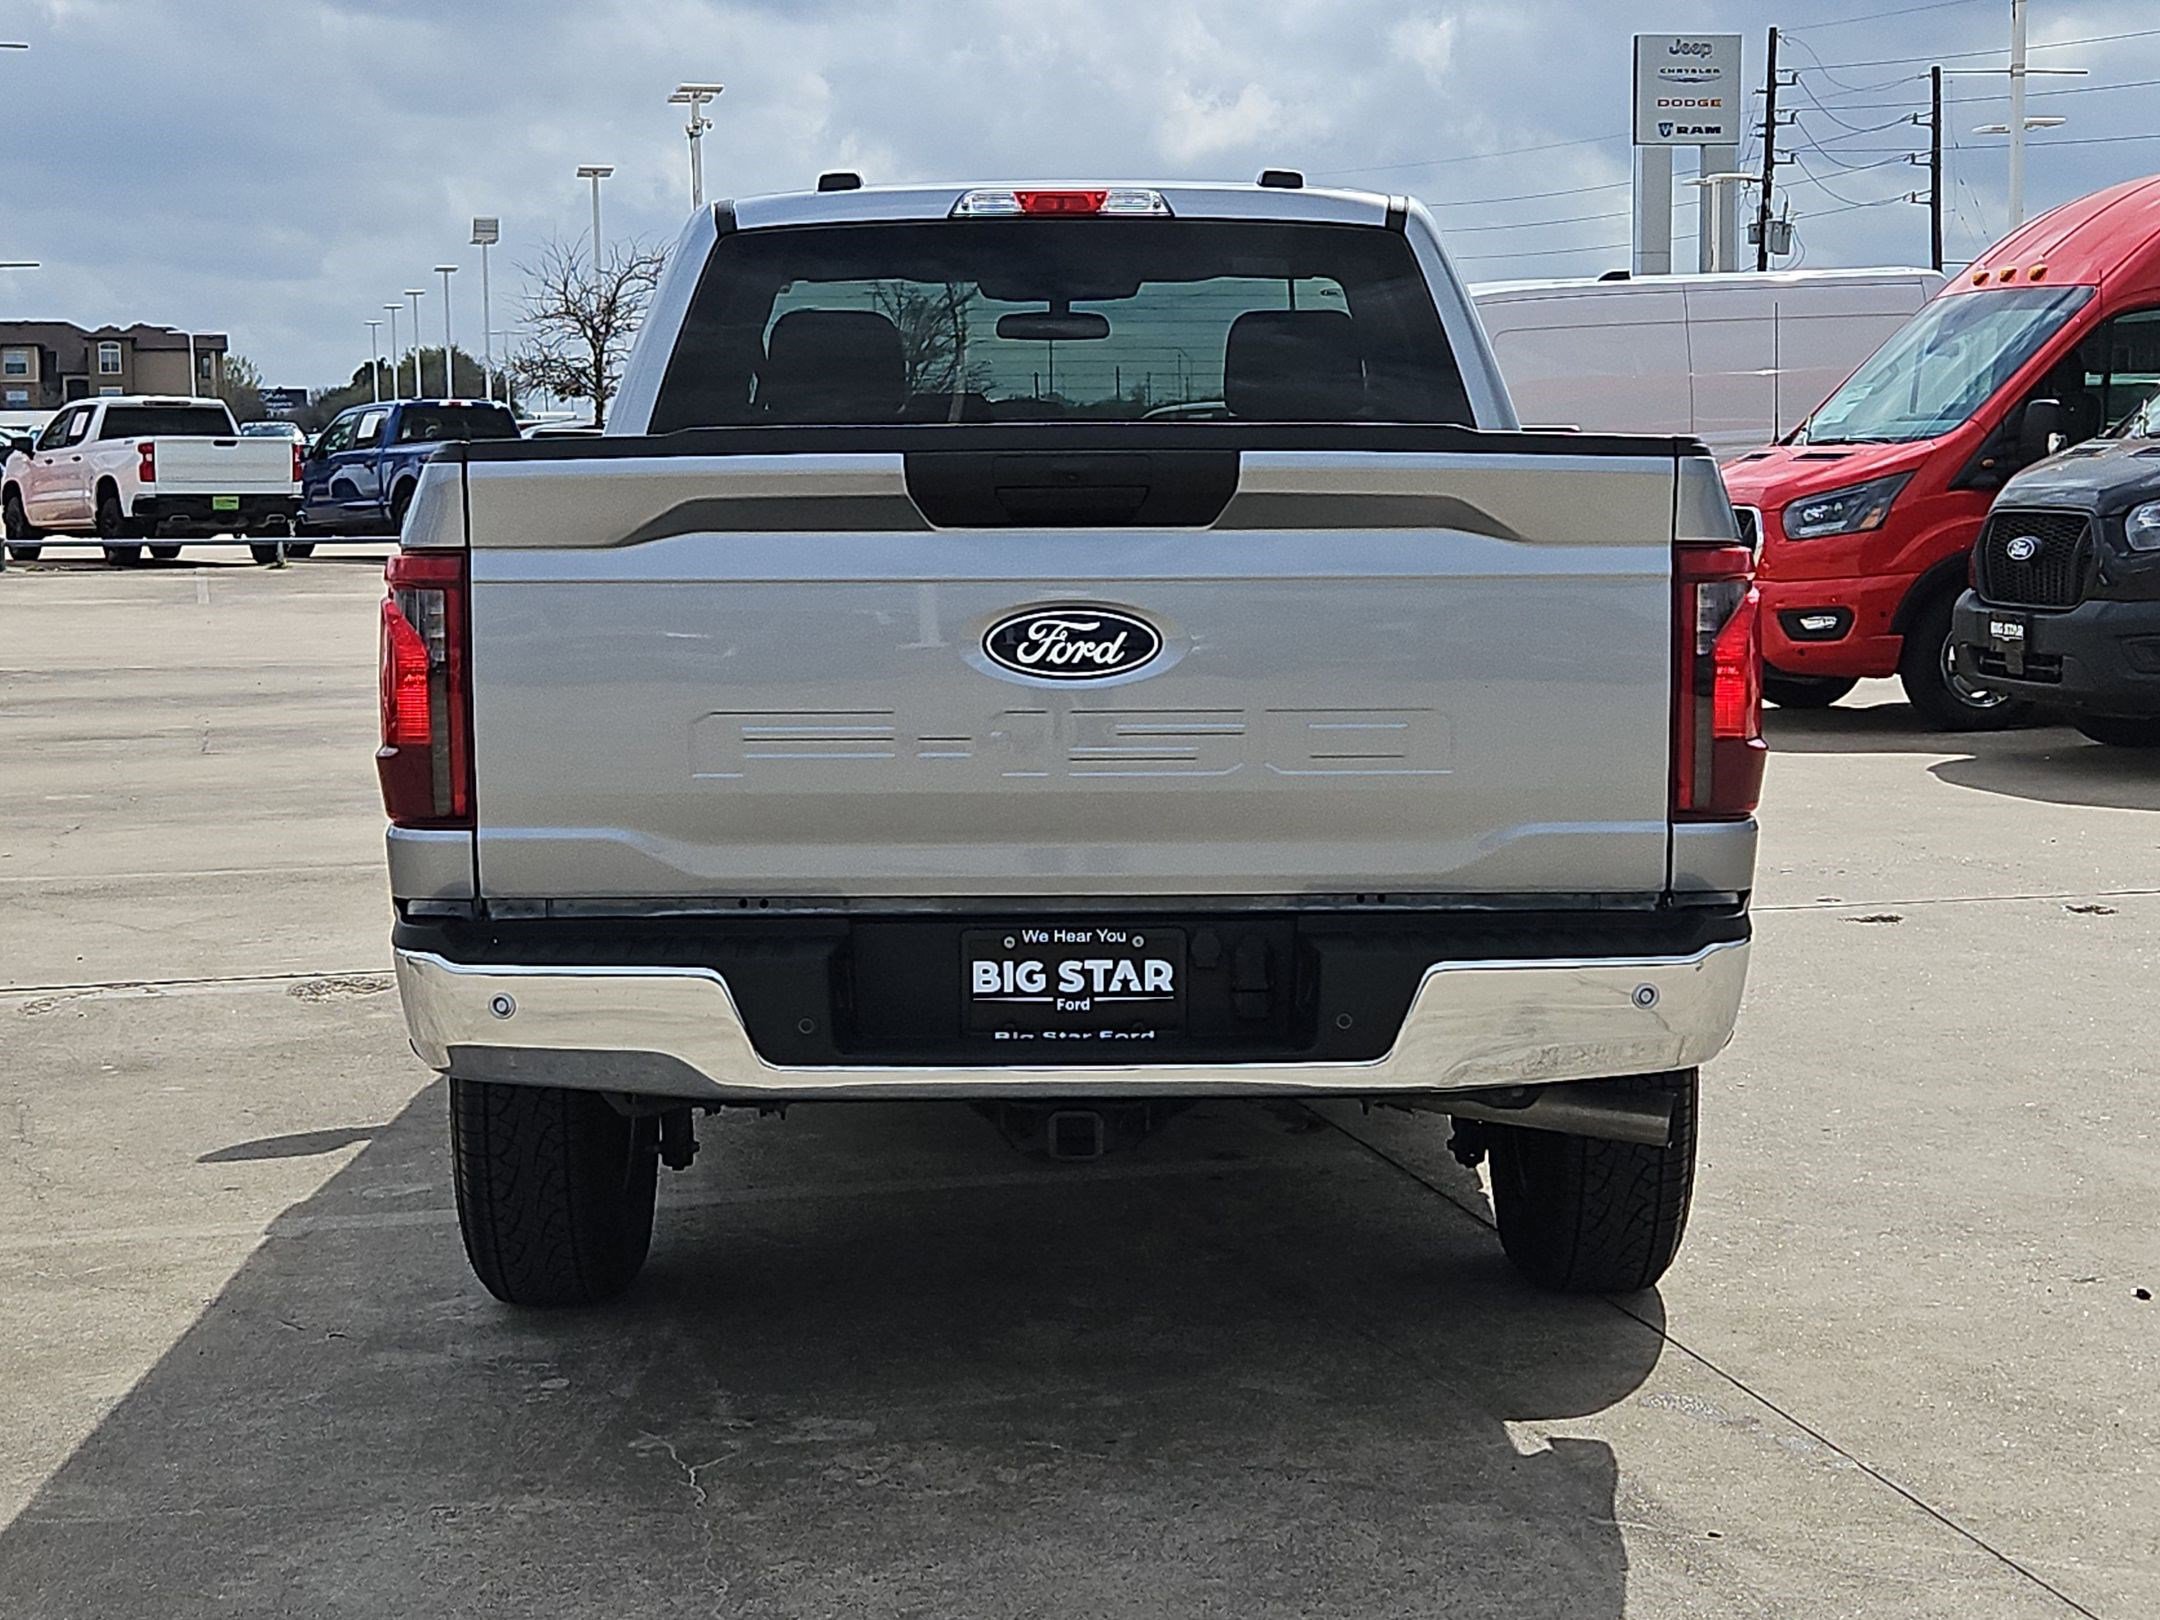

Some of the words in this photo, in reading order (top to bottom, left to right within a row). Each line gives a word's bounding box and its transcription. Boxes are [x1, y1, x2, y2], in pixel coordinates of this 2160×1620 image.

[1669, 38, 1712, 59] Jeep
[1659, 67, 1721, 75] CHRYSLER
[1657, 98, 1722, 107] DODGE
[1676, 125, 1722, 134] RAM
[1016, 619, 1128, 664] Ford
[692, 710, 1454, 778] F-150
[1022, 929, 1049, 943] We
[1053, 929, 1092, 943] Hear
[1096, 928, 1127, 943] You
[972, 960, 1047, 993] BIG
[1058, 959, 1174, 993] STAR
[1056, 998, 1091, 1011] Ford
